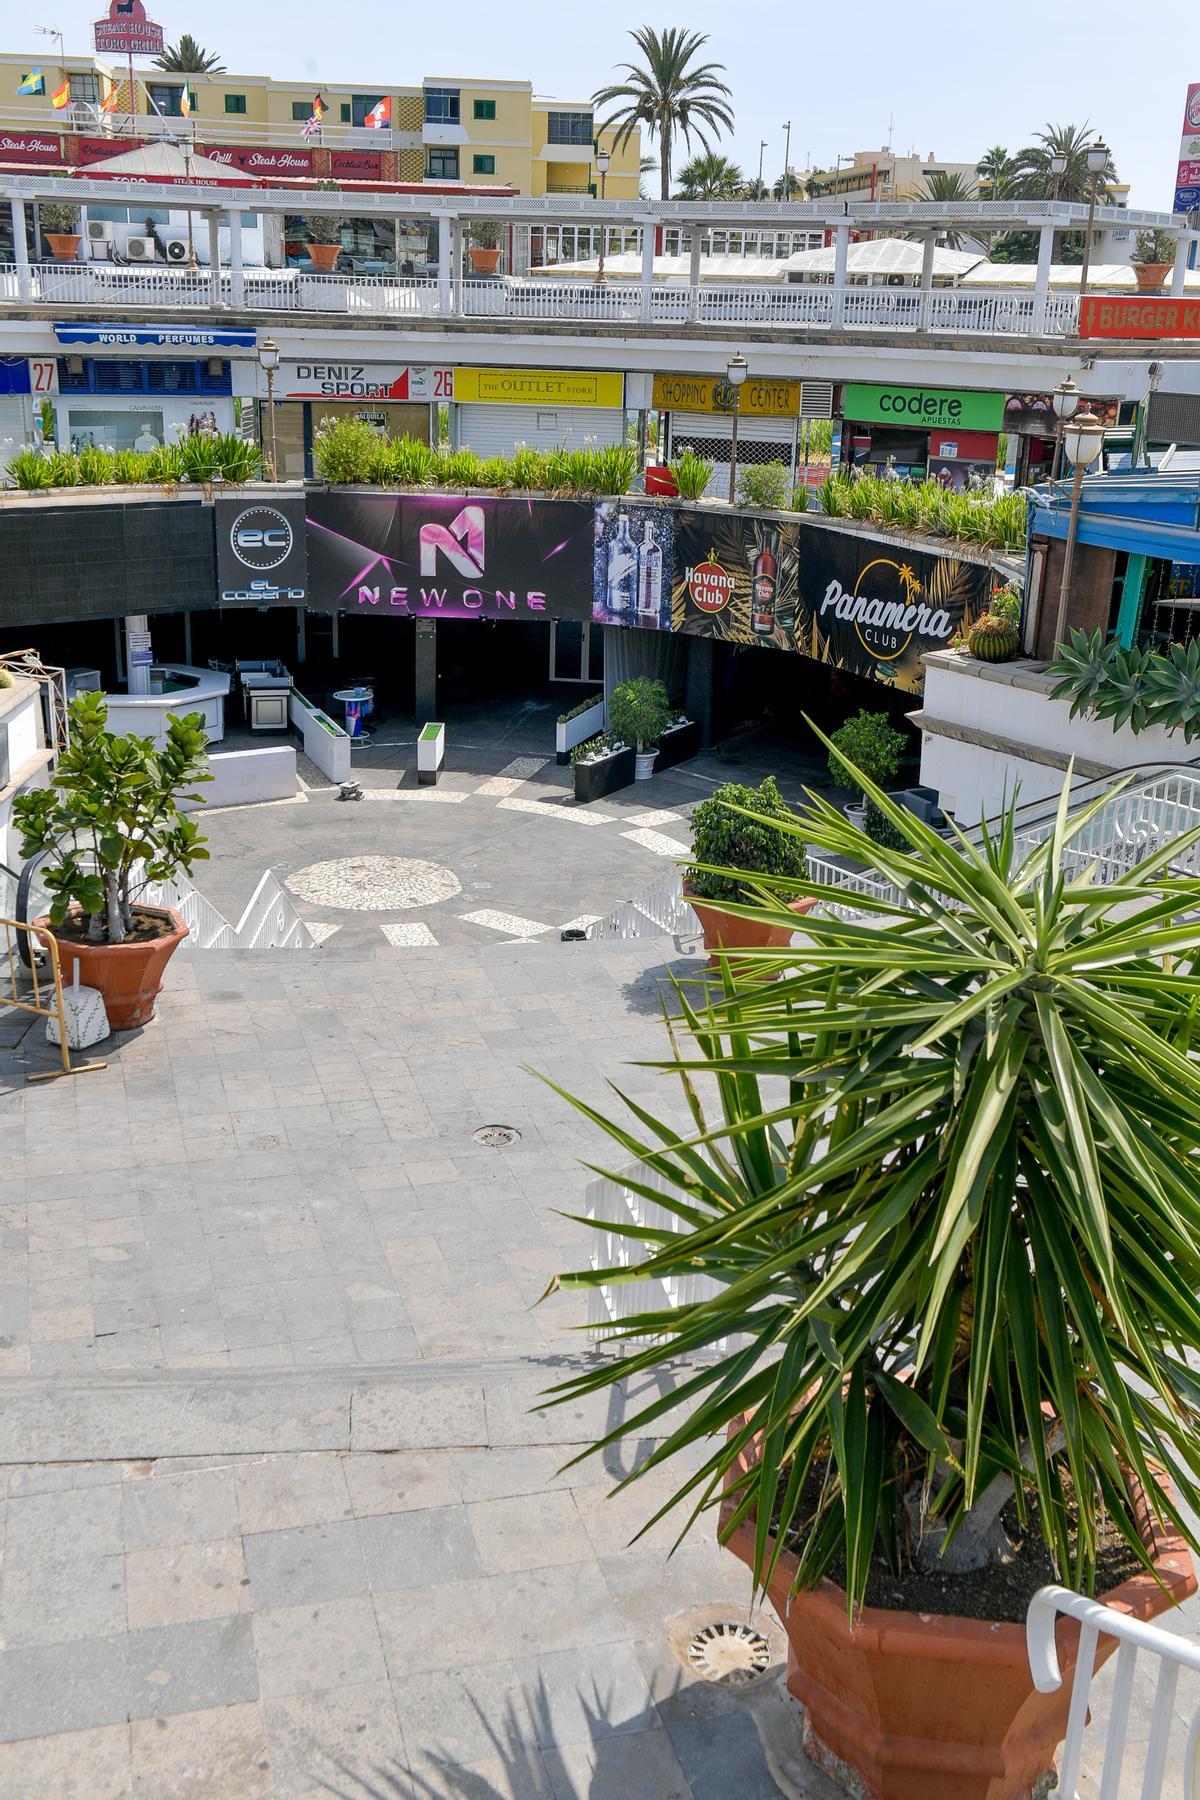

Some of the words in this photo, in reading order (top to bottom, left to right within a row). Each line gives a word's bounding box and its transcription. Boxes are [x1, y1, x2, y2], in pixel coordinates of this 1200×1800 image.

[96, 22, 128, 35] STEAK
[130, 22, 161, 38] HOUSE
[97, 38, 128, 50] TORO
[130, 40, 162, 51] GRILL
[0, 138, 26, 151] Steak
[26, 140, 58, 152] House
[249, 153, 277, 166] Steak
[277, 155, 309, 167] House
[333, 158, 363, 169] Cocktail
[363, 160, 378, 170] Bar
[1100, 303, 1178, 330] BURGER
[99, 334, 137, 343] WORLD
[158, 334, 215, 344] PERFUMES
[33, 363, 54, 392] 27
[297, 365, 365, 381] DENIZ
[321, 381, 393, 397] SPORT
[433, 370, 453, 397] 26
[483, 383, 500, 391] THE
[501, 379, 565, 393] OUTLET
[662, 382, 707, 404] SHOPPING
[751, 387, 790, 408] CENTER
[879, 393, 962, 417] codere
[921, 416, 961, 426] APUESTAS
[685, 566, 735, 589] Havana
[358, 585, 447, 607] NEW
[462, 588, 546, 611] ONE
[694, 586, 723, 605] Club
[820, 579, 953, 638] Panamera
[865, 629, 897, 649] CLUB
